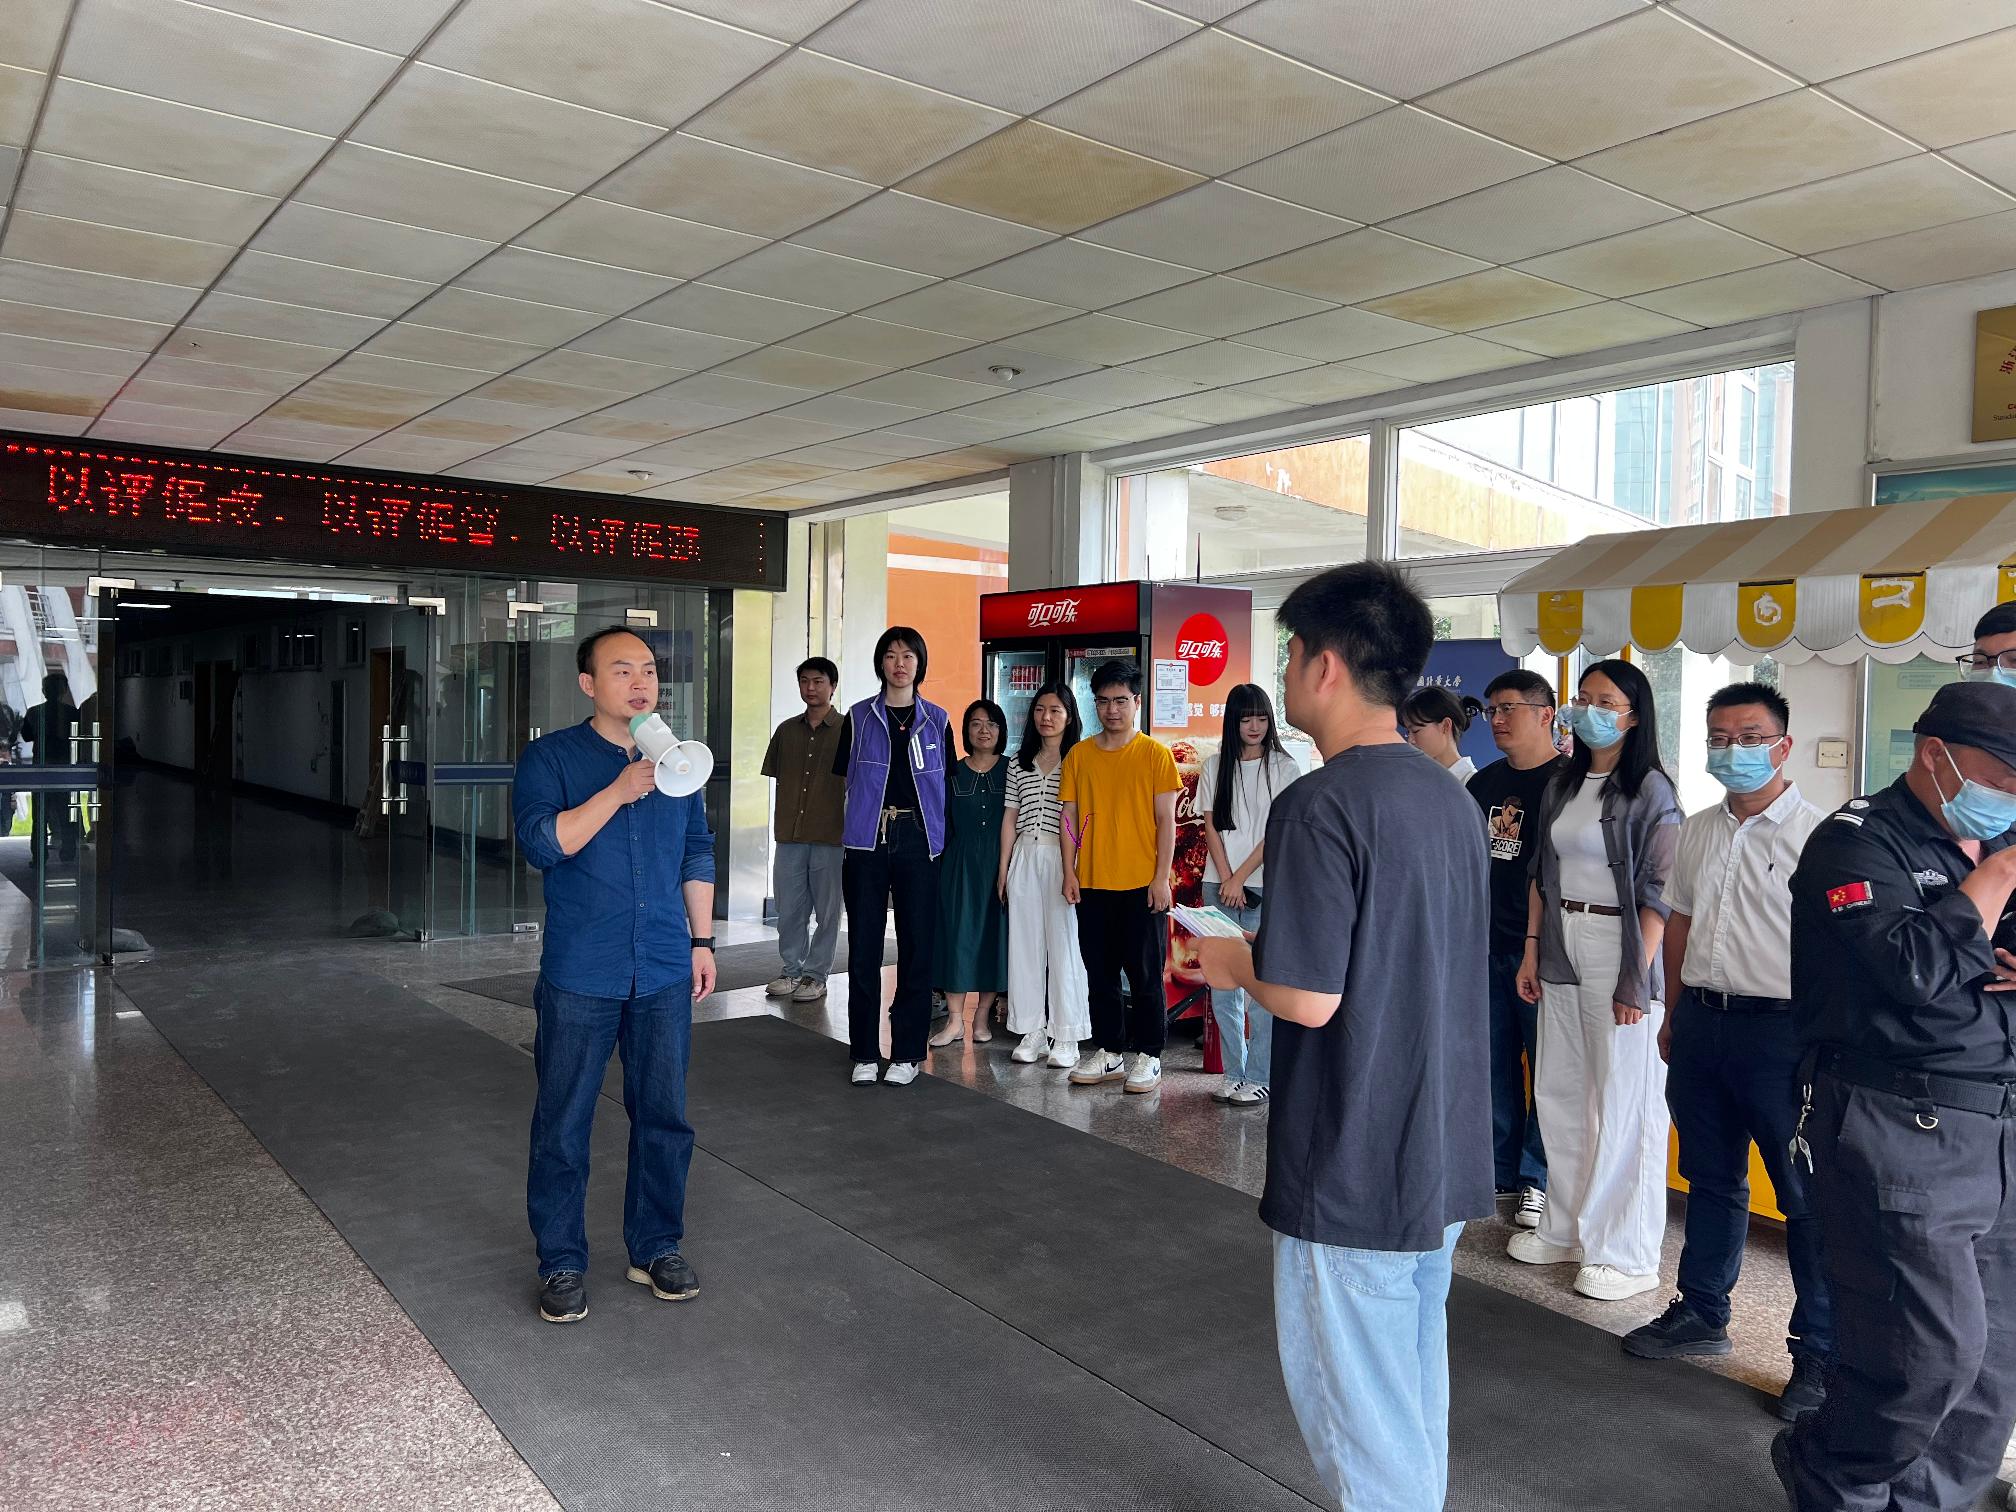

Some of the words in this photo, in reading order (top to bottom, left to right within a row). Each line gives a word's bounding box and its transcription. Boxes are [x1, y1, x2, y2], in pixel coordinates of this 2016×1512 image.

[1028, 599, 1082, 628] 可口可乐
[1178, 640, 1226, 659] 可口可乐
